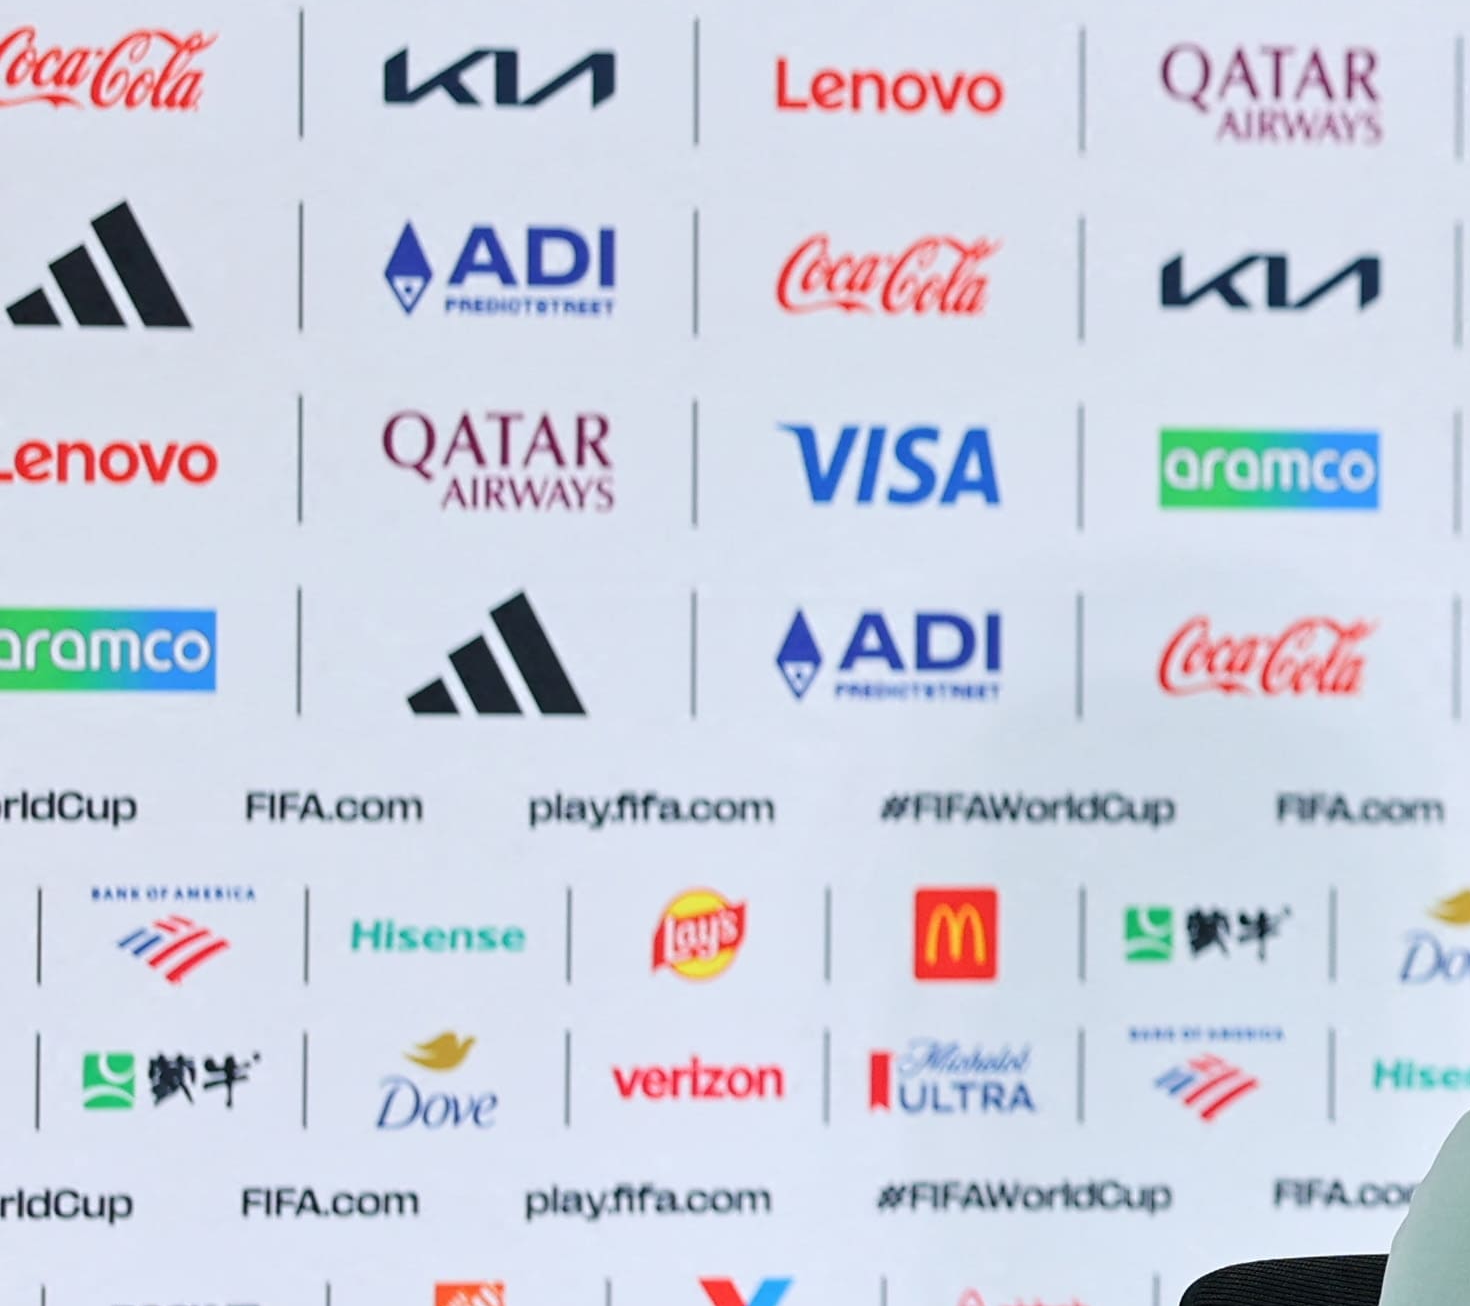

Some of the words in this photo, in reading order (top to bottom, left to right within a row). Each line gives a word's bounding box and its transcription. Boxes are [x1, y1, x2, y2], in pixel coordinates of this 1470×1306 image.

[775, 57, 1004, 115] Lenovo
[1159, 45, 1379, 115] QATAR
[1217, 108, 1383, 143] AIRWAYS
[447, 224, 616, 288] ADI
[775, 235, 993, 316] Coca-Cola
[381, 412, 611, 484] QATAR
[782, 424, 1001, 507] VISA
[1163, 448, 1376, 492] aramco
[441, 476, 615, 510] AIRWAYS
[0, 629, 211, 672] aramco
[837, 611, 1002, 673] ADI
[1156, 617, 1369, 696] Coca-Cola
[0, 790, 138, 828] rldCup
[245, 791, 423, 823] FIFA.com
[528, 792, 775, 830] play.fifa.com
[880, 792, 1176, 829] #FIFAWorldCup
[1275, 792, 1445, 825] FIFA.com
[92, 888, 139, 900] BANK
[146, 887, 168, 900] OF
[175, 887, 255, 900] AMERICA
[350, 919, 526, 952] Hisense
[663, 908, 740, 964] Lay's
[612, 1056, 785, 1100] verizon
[897, 1080, 1037, 1114] ULTRA
[375, 1070, 498, 1130] Dove
[241, 1187, 419, 1217] FIFA.com
[525, 1183, 772, 1223] play.fifa.com
[876, 1179, 1173, 1215] #FIFAWorldCup
